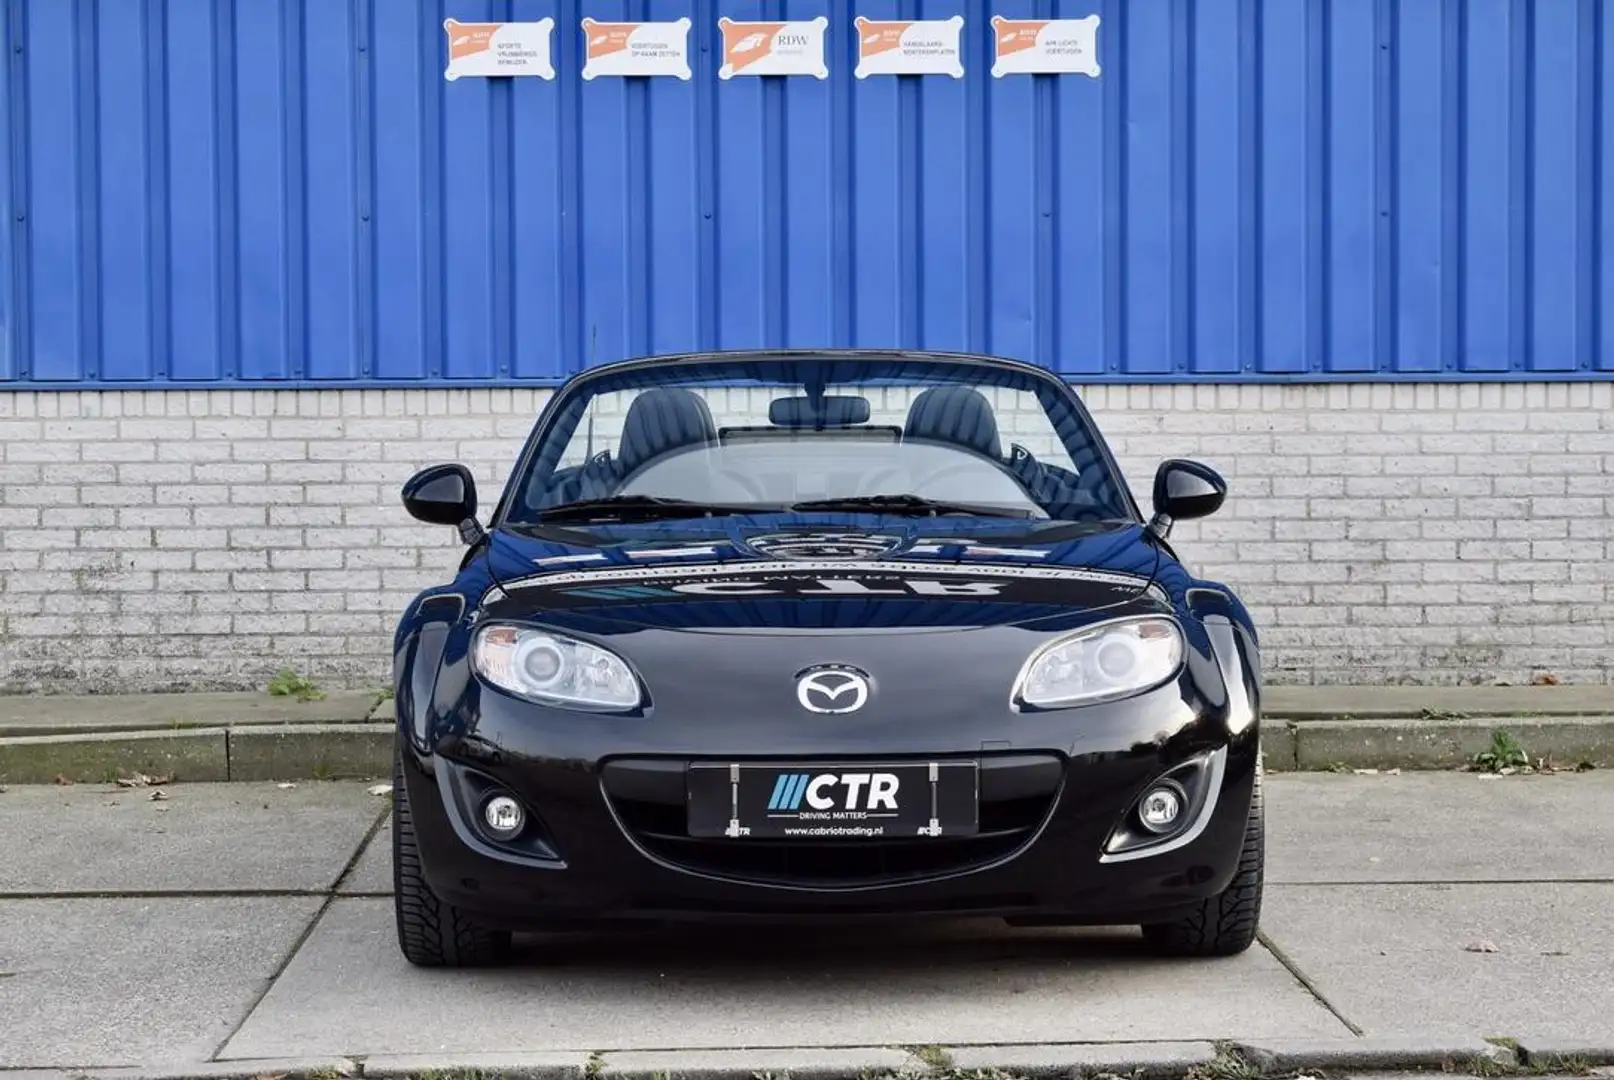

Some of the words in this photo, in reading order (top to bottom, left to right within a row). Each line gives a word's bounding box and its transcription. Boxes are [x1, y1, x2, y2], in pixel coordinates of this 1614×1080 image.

[779, 35, 807, 45] RDW
[805, 772, 900, 811] CTR
[799, 812, 831, 820] DRIVING
[832, 812, 867, 820] MATTERS
[784, 826, 884, 837] www.cabriotrading.nl
